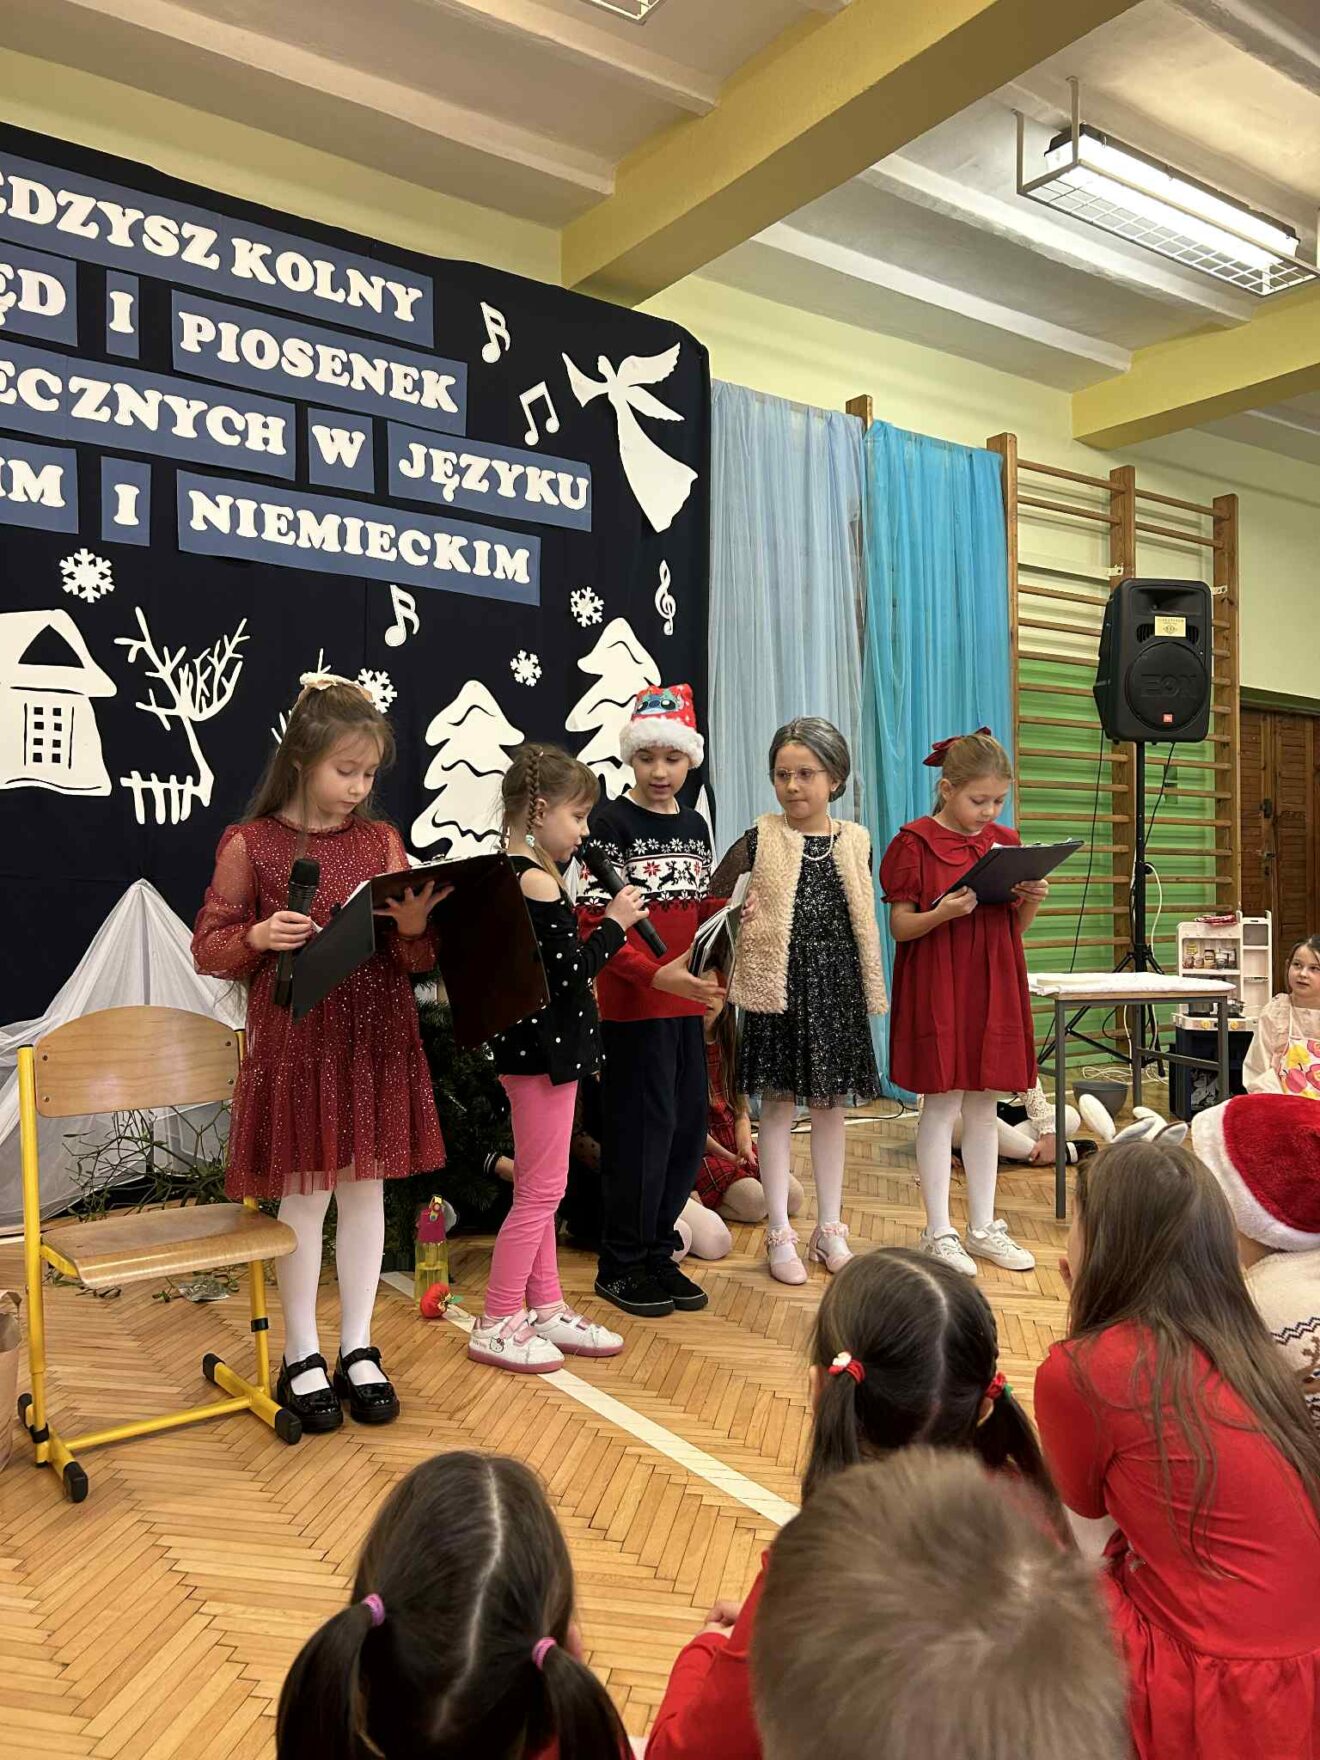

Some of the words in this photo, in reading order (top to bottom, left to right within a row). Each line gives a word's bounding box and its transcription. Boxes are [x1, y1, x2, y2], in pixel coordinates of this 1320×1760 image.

[0, 171, 220, 271] DZYSZ
[108, 290, 135, 335] I
[178, 311, 458, 414] PIOSENEK
[0, 456, 66, 508] M
[113, 483, 140, 526] I
[188, 489, 531, 585] NIEMIECKIM
[311, 424, 366, 469] W
[398, 442, 590, 511] JĘZYKU
